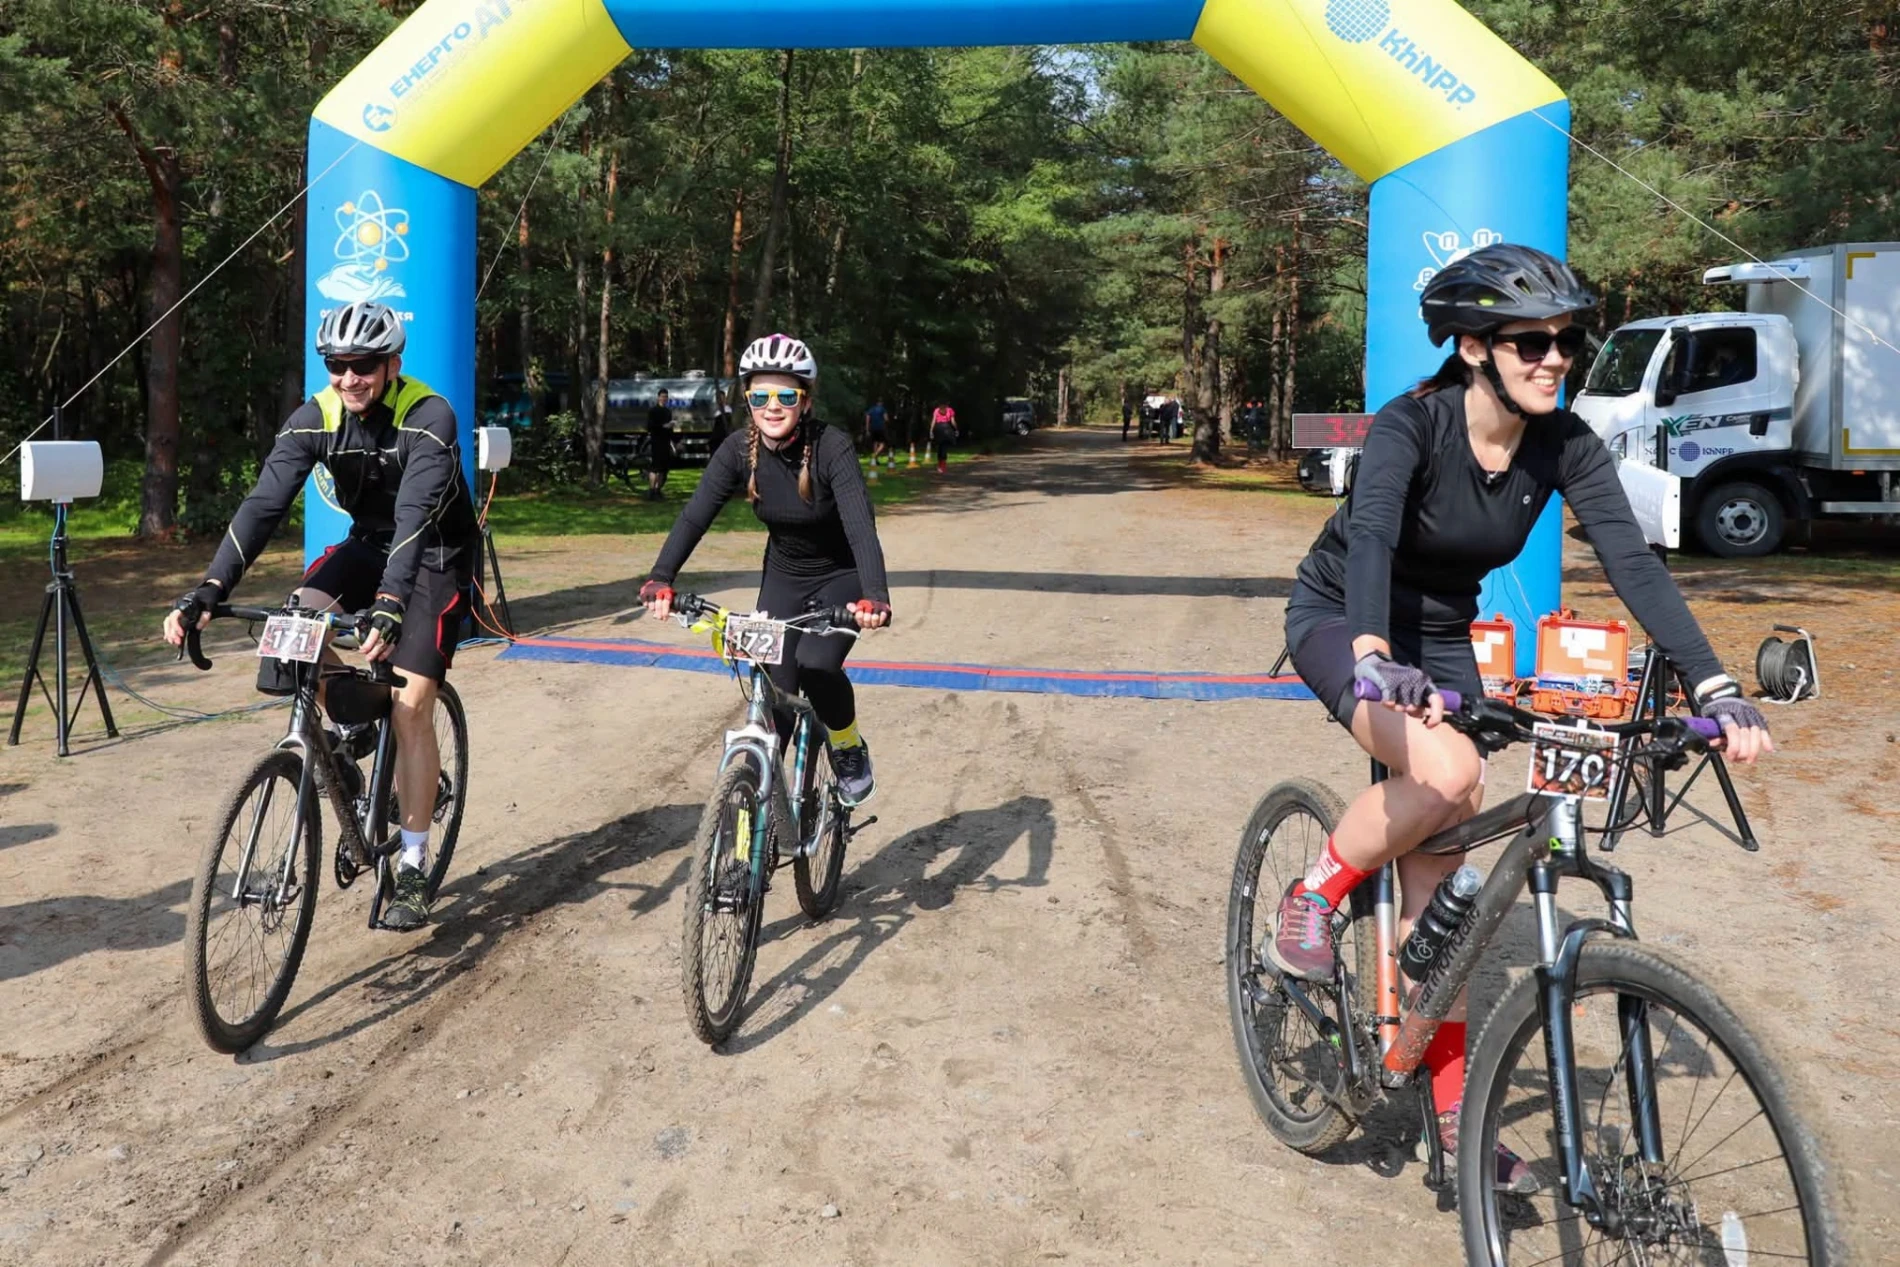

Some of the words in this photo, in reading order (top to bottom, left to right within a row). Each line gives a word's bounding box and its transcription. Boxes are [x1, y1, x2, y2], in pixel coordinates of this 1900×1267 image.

[1378, 28, 1477, 110] KhNPP
[272, 629, 309, 653] 171
[732, 630, 774, 654] 172
[1542, 747, 1604, 786] 170
